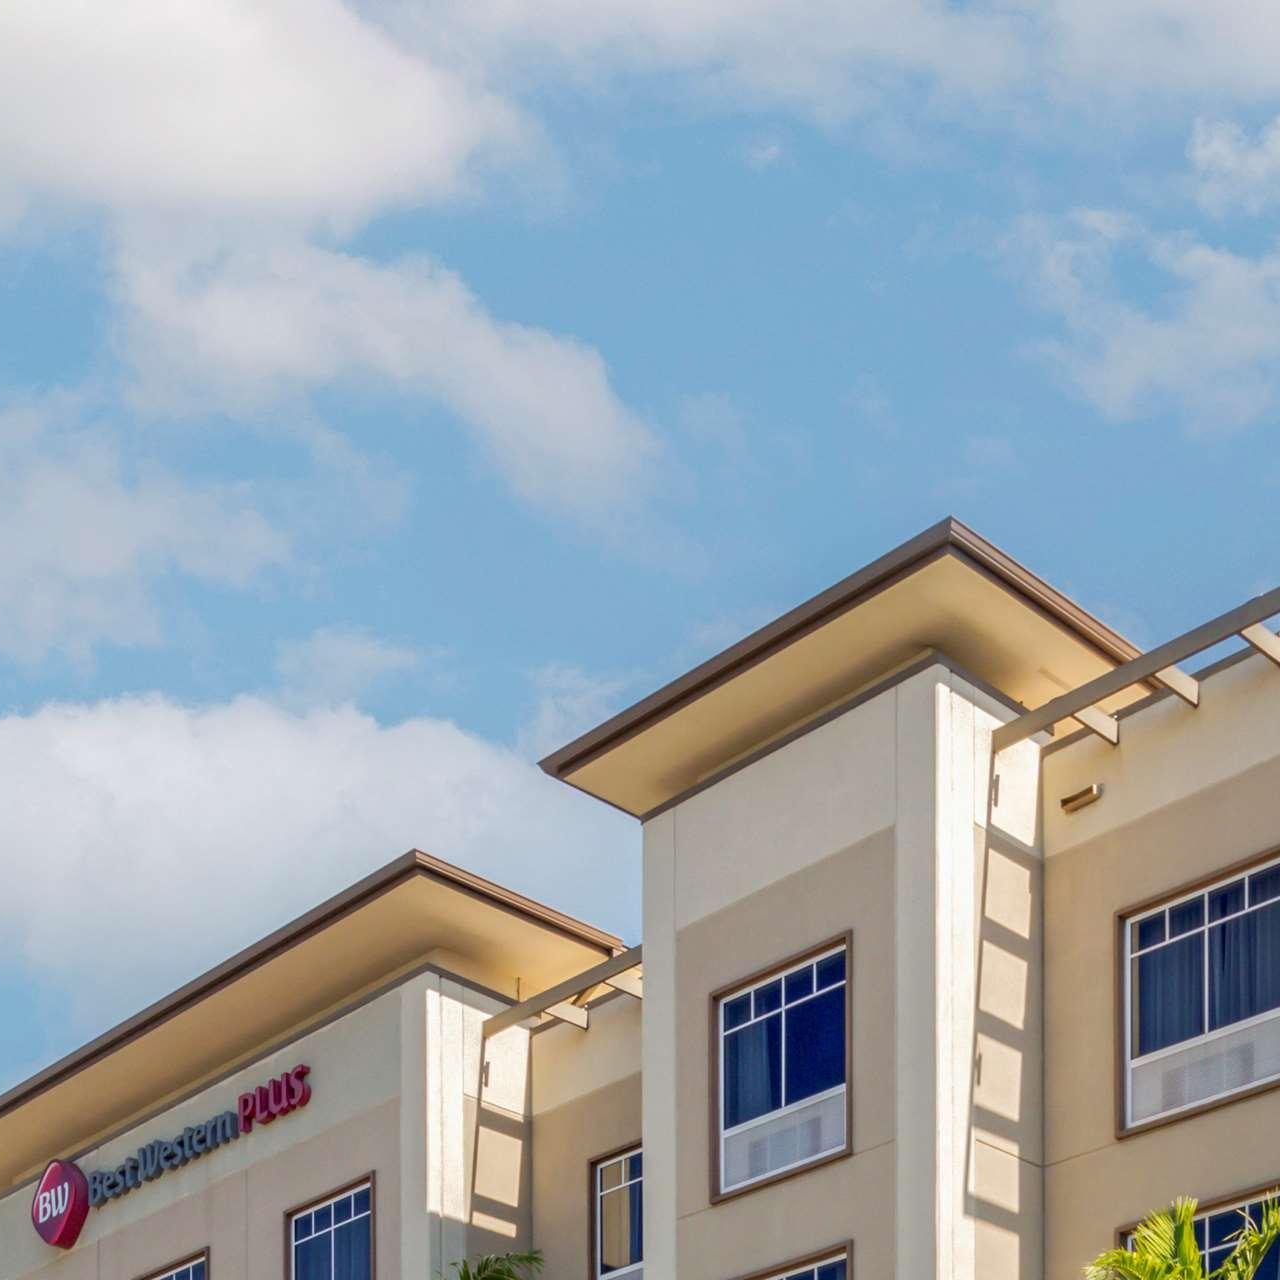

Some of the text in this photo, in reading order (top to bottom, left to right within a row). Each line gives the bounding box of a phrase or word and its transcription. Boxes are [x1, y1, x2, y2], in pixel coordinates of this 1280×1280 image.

[88, 1064, 312, 1207] Best Western PLUS
[38, 1182, 69, 1223] BW
